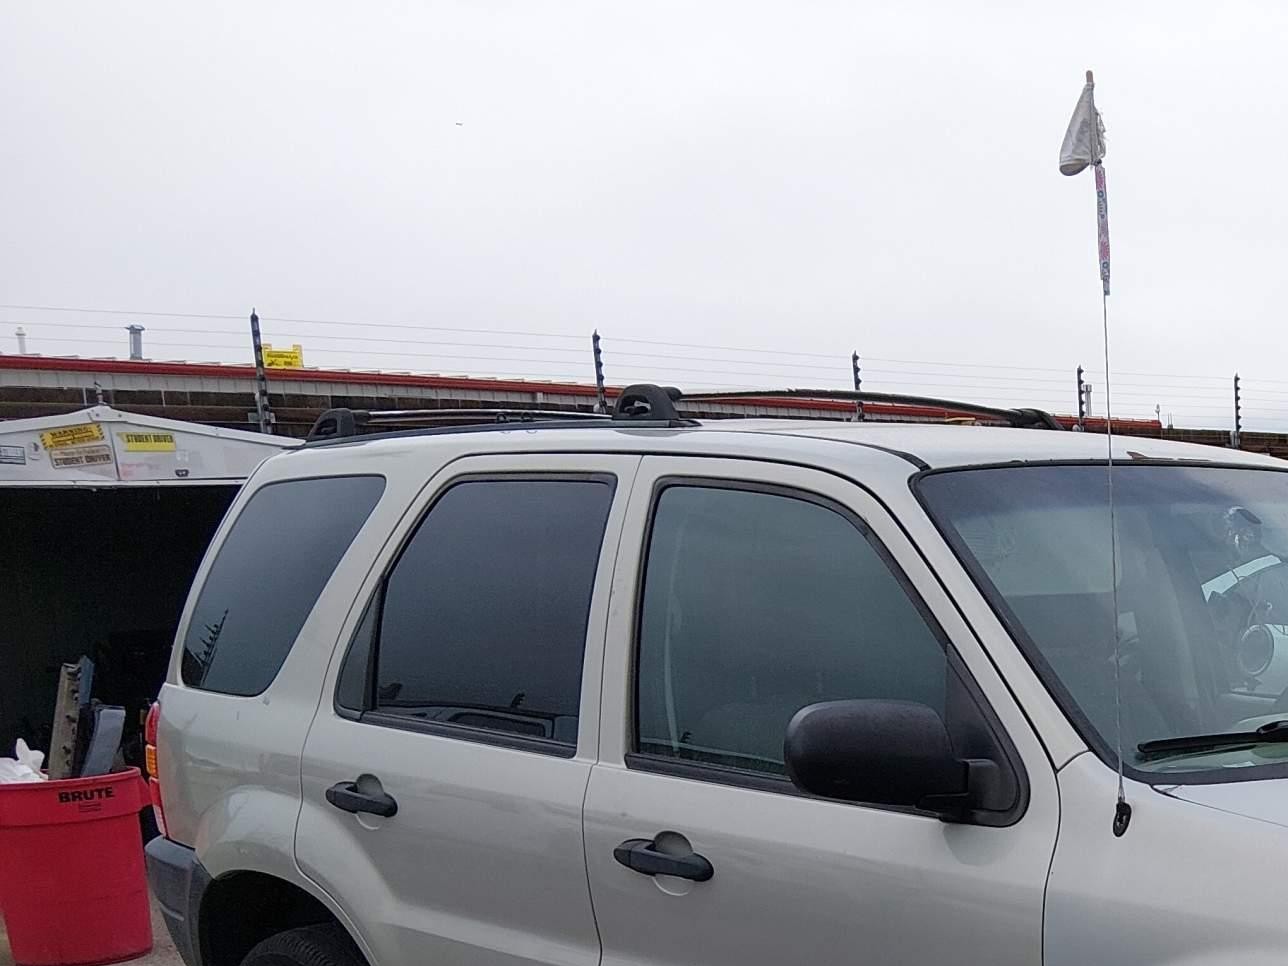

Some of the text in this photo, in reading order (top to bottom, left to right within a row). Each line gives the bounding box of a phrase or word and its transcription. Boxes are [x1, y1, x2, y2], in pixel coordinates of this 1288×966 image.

[126, 434, 174, 443] STUDENT DRIVER
[54, 454, 111, 466] STUDENT DRIVER
[58, 787, 115, 803] BRUTE
